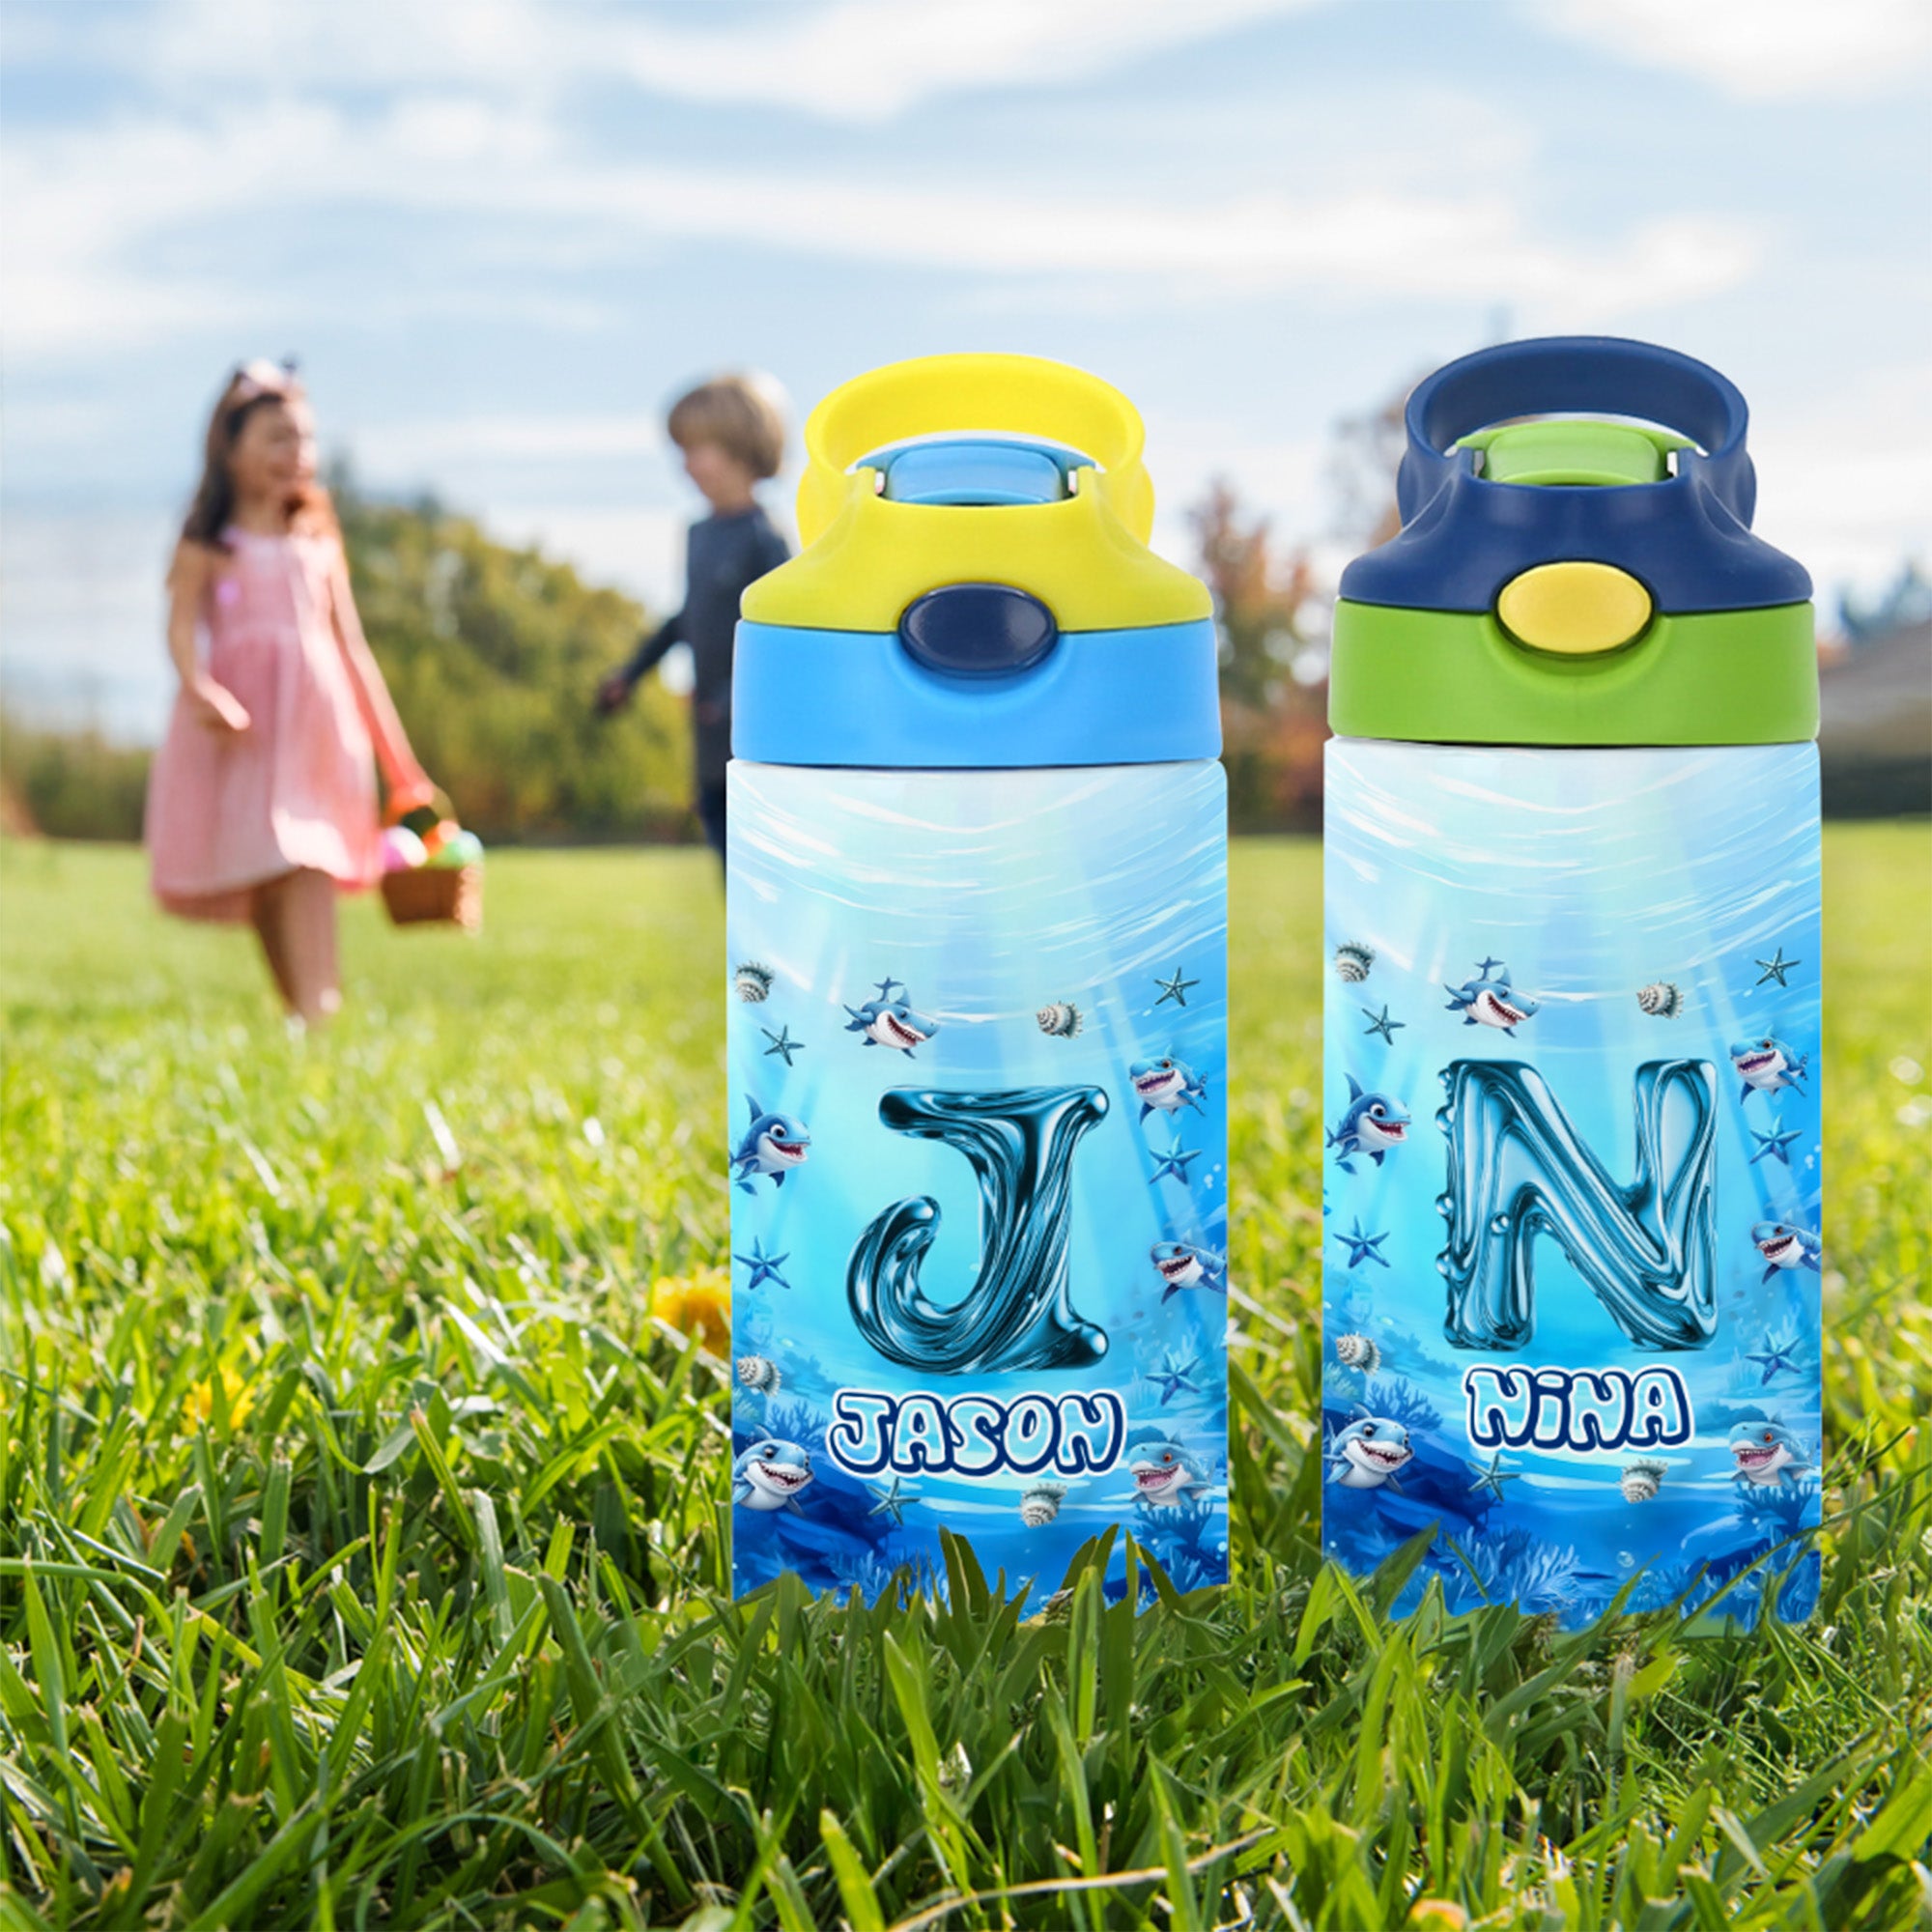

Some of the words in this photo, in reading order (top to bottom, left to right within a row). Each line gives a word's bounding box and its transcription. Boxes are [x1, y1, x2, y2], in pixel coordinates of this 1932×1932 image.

[846, 1085, 1110, 1376] J
[1436, 1059, 1718, 1352] N
[828, 1390, 1125, 1476] JASON
